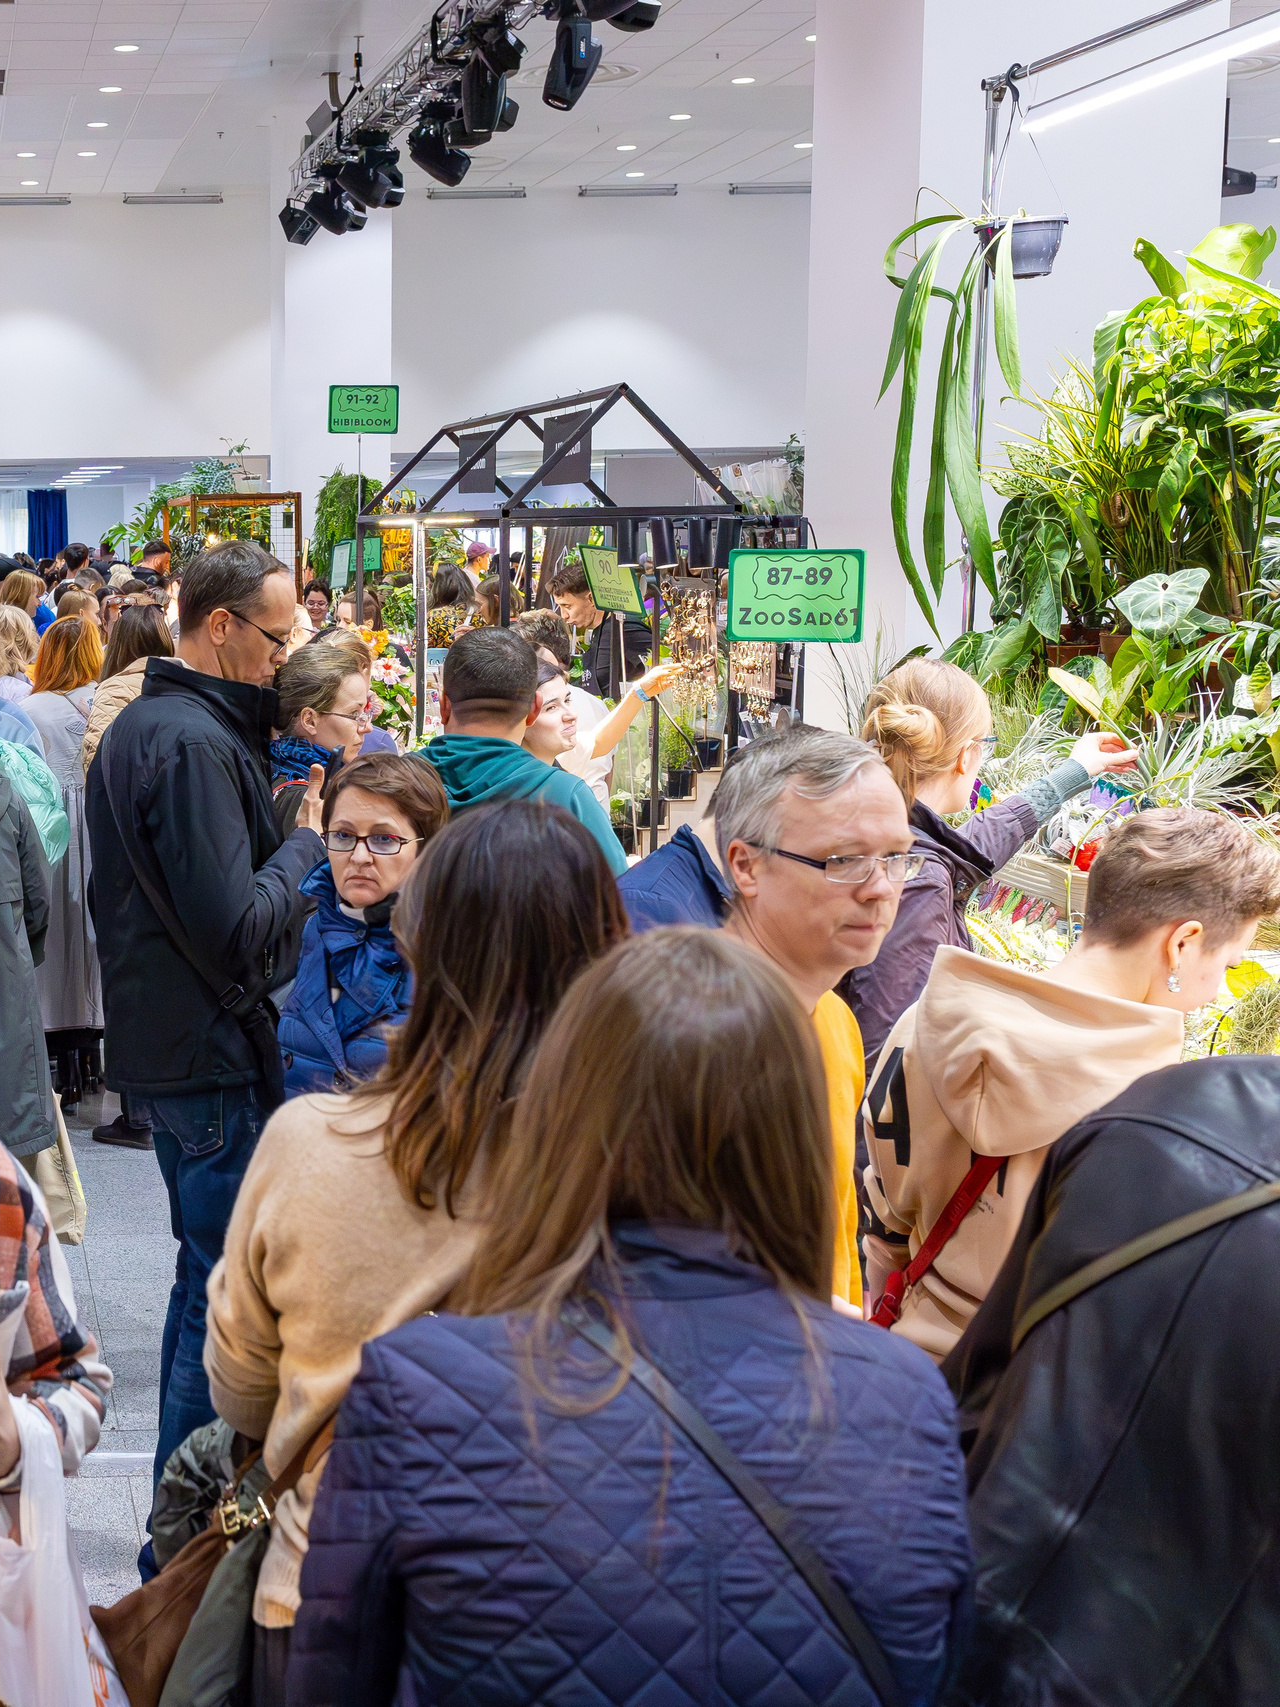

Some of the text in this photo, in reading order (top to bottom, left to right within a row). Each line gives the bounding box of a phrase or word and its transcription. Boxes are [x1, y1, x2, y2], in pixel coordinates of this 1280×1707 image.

[346, 394, 379, 404] 91-92
[333, 418, 391, 426] HIBIBLOOM
[598, 559, 612, 576] 90
[766, 567, 833, 585] 87-89
